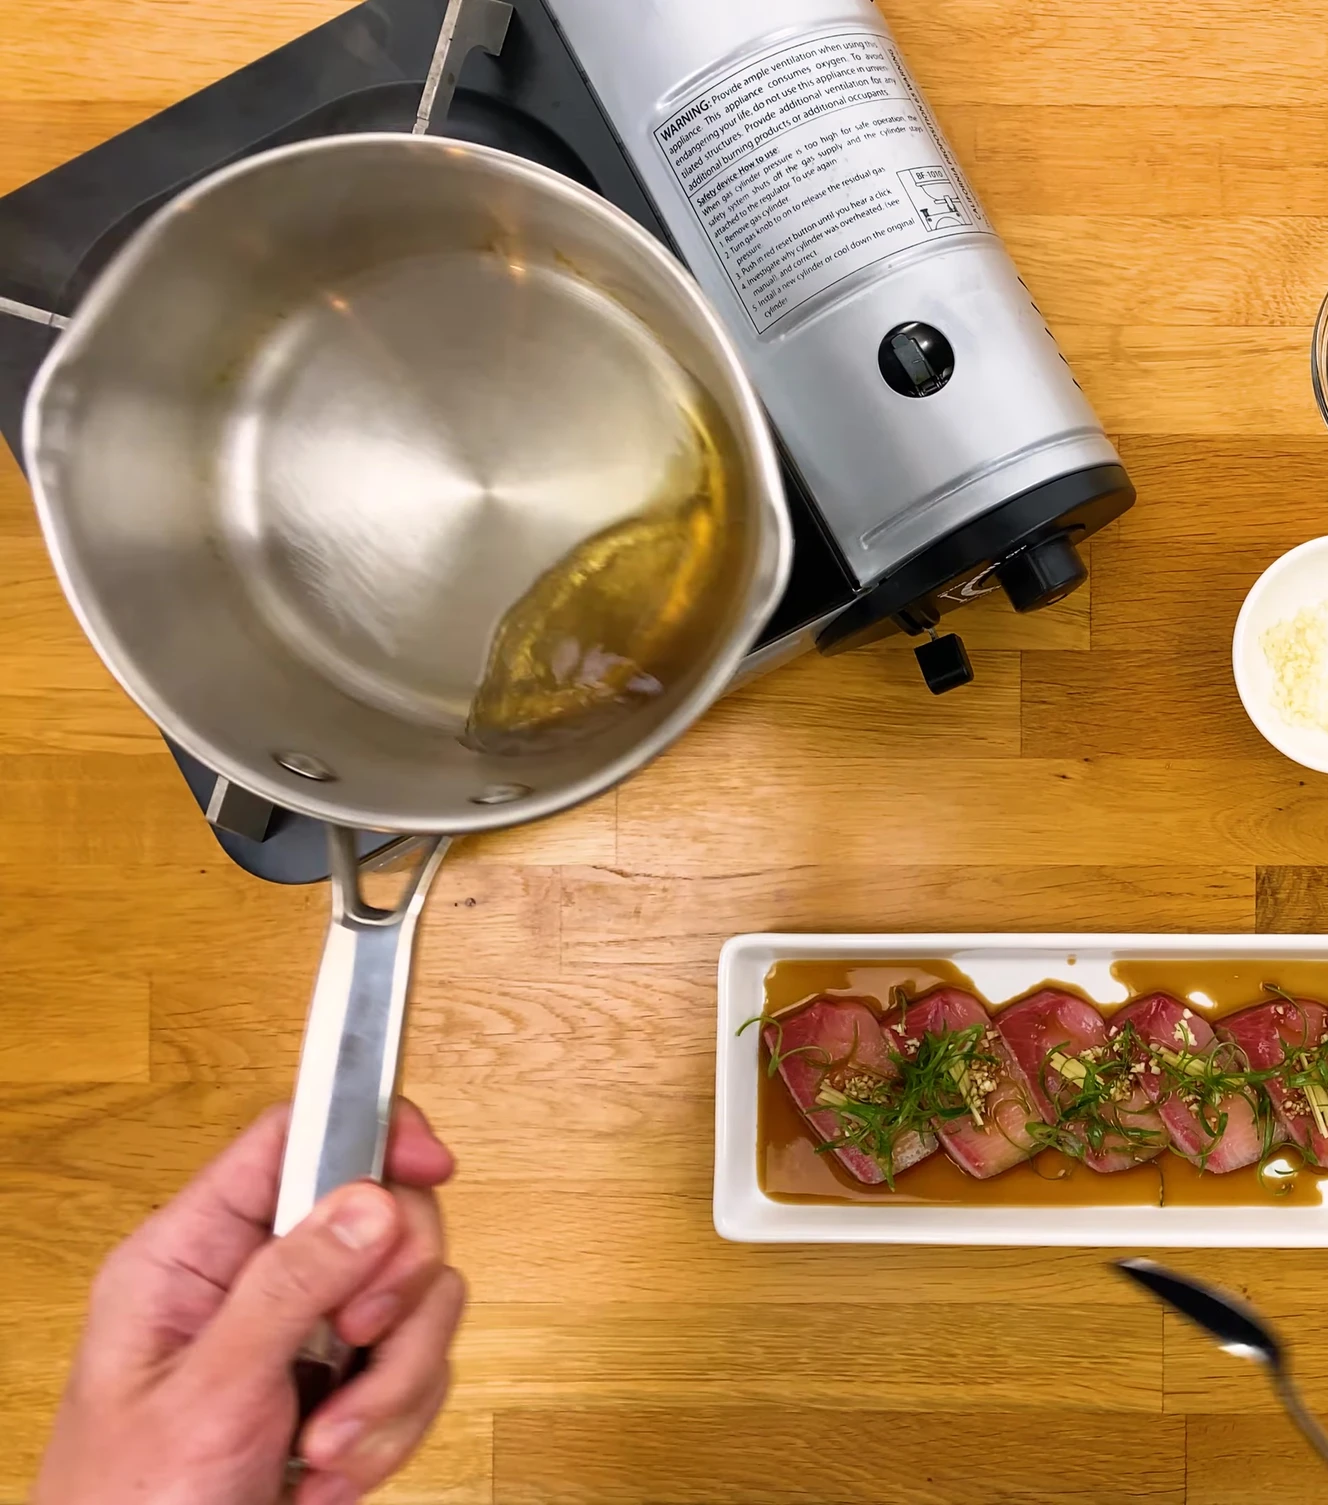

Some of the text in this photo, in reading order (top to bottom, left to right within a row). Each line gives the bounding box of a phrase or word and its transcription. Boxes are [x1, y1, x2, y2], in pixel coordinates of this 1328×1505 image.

[660, 39, 878, 141] WARNING: Provide ample ventilation when using this
[668, 124, 704, 155] appliance.
[703, 110, 722, 126] This
[724, 85, 764, 113] appliance
[767, 66, 812, 89] consumes
[850, 52, 862, 61] To
[865, 52, 884, 60] avoid
[888, 48, 913, 92] WARNING
[675, 130, 720, 167] endangering
[718, 118, 738, 135] your
[737, 108, 754, 122] life,
[752, 101, 765, 112] do
[765, 93, 781, 106] not
[781, 86, 797, 98] use
[797, 77, 815, 91] this
[816, 68, 855, 85] appliance
[857, 65, 865, 73] in
[681, 76, 897, 179] tilated structures. Provide additional ventilation for any
[687, 162, 723, 192] additional
[723, 140, 754, 164] burning
[753, 118, 792, 146] products
[792, 113, 802, 123] or
[803, 96, 847, 119] additional
[917, 103, 953, 165] PROPOSITION
[696, 187, 717, 208] Safety
[755, 154, 764, 163] to
[701, 200, 721, 217] When
[721, 190, 733, 203] gas
[734, 171, 761, 193] cylinder
[763, 152, 793, 175] pressure
[804, 140, 818, 150] too
[820, 131, 839, 144] high
[840, 127, 852, 135] for
[854, 121, 870, 131] safe
[708, 125, 923, 227] safety system shuts off the gas supply and the cylinder stays
[714, 214, 740, 238] attached
[739, 209, 748, 219] to
[747, 201, 759, 210] the
[791, 175, 802, 184] To
[802, 168, 815, 179] use
[729, 240, 746, 254] Turn
[744, 233, 757, 246] gas
[755, 220, 774, 235] knob
[773, 214, 782, 223] to
[782, 209, 792, 219] on
[792, 203, 801, 212] to
[801, 188, 827, 207] release
[827, 181, 841, 193] the
[841, 169, 872, 186] residual
[872, 166, 886, 176] gas
[915, 170, 944, 180] BF-1010
[950, 167, 982, 220] CALIFORNIA
[724, 222, 750, 244] Remove
[750, 215, 762, 227] gas
[741, 261, 758, 276] Push
[757, 256, 764, 264] in
[763, 247, 775, 258] red
[775, 236, 793, 251] reset
[792, 221, 818, 240] button
[818, 210, 835, 226] until
[835, 205, 851, 218] you
[850, 197, 868, 208] hear
[874, 188, 892, 199] click
[747, 261, 781, 286] Investigate
[781, 249, 796, 262] why
[796, 232, 824, 253] cylinder
[824, 225, 840, 236] was
[885, 199, 900, 209] (see
[758, 289, 778, 307] Install
[782, 278, 796, 290] new
[796, 259, 824, 281] cylinder
[824, 255, 833, 263] or
[833, 245, 850, 259] cool
[850, 236, 872, 250] down
[872, 228, 886, 239] the
[886, 218, 915, 233] original
[779, 265, 793, 278] and
